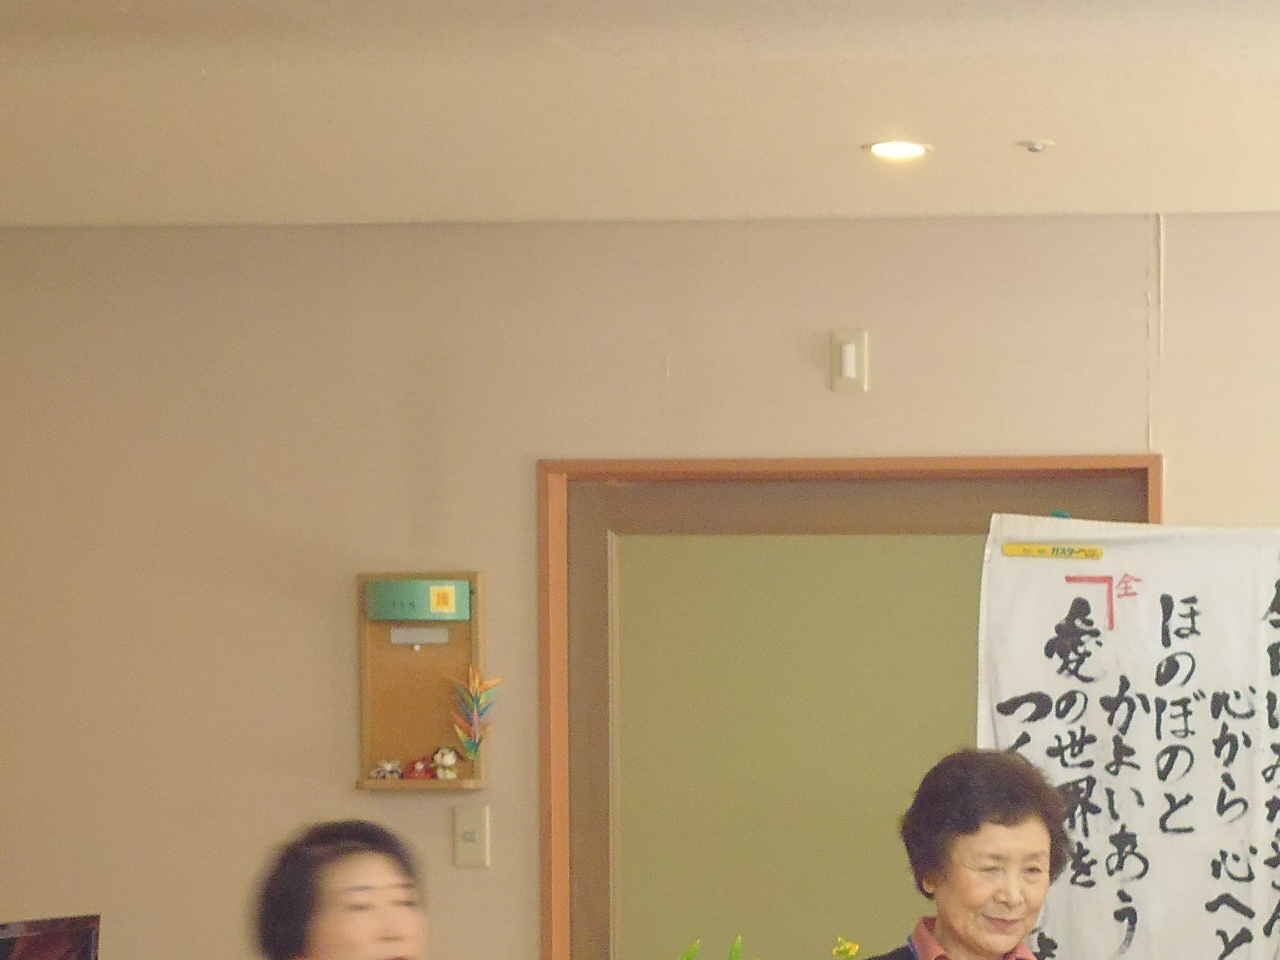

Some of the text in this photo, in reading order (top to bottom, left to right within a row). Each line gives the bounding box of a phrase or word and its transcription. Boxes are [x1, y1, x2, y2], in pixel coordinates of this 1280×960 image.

[1116, 573, 1142, 599] 全
[1100, 675, 1151, 957] かよいあう
[1154, 594, 1206, 834] ほのぼのと
